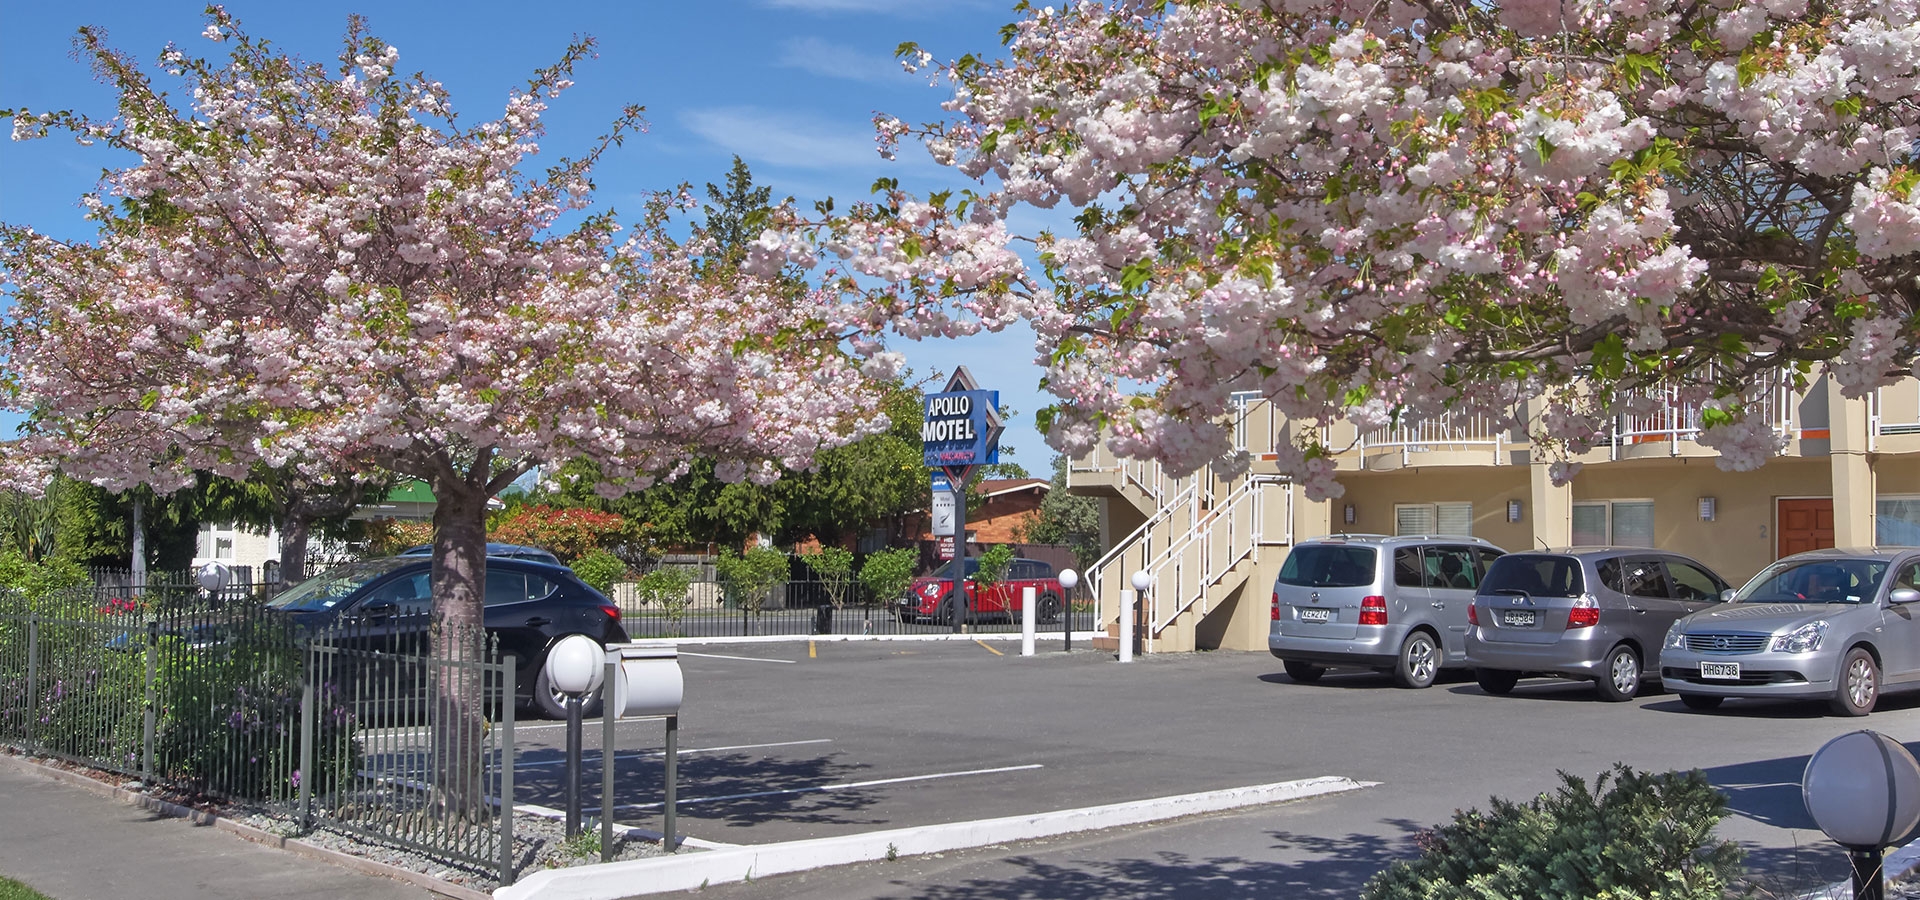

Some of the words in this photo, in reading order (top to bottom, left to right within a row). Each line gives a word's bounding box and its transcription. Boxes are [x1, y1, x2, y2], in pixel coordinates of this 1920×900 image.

[928, 395, 969, 417] APOLLO
[922, 418, 973, 442] MOTEL
[1760, 525, 1768, 538] 2
[1703, 664, 1738, 676] HHG738
